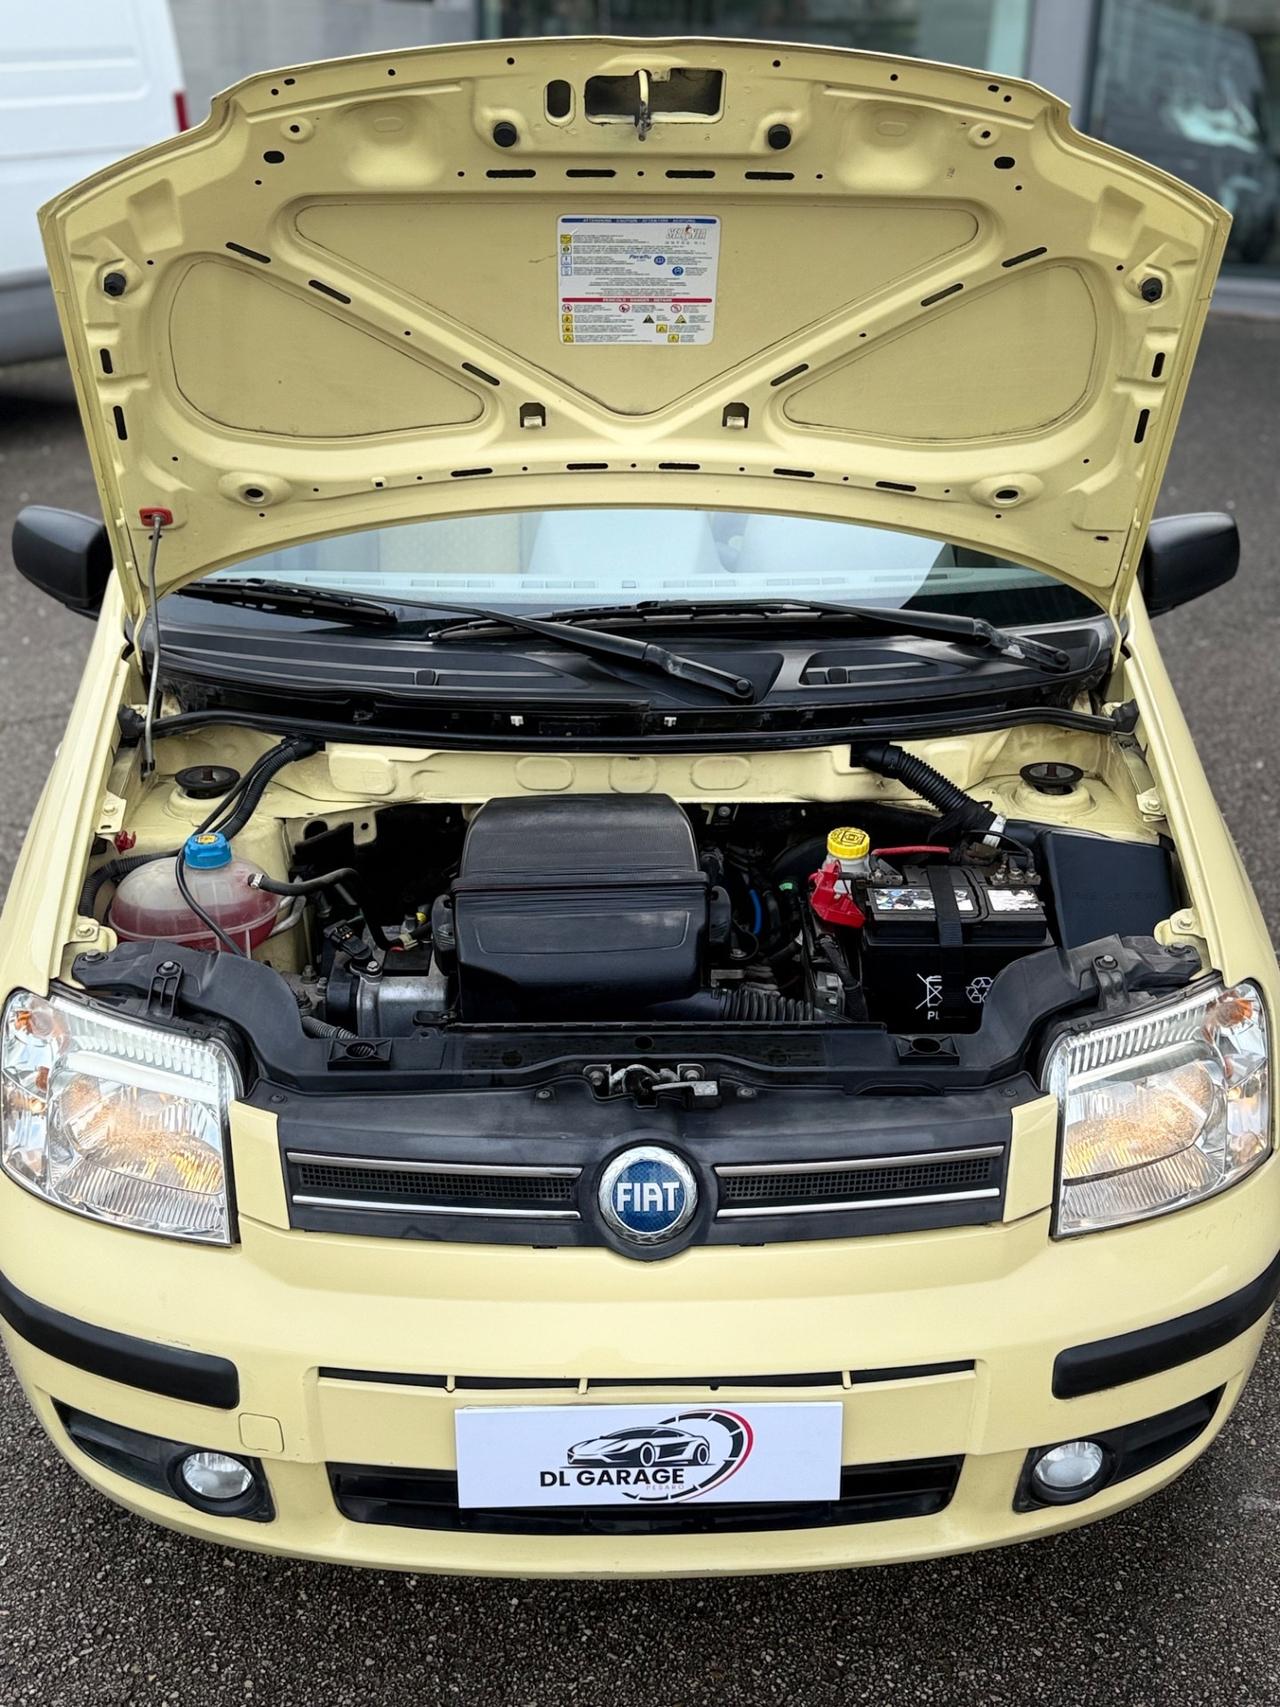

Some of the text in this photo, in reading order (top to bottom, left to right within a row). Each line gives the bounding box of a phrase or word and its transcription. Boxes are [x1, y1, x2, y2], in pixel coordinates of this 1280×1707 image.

[616, 1182, 680, 1212] FIAT
[540, 1468, 685, 1487] DL GARAGE
